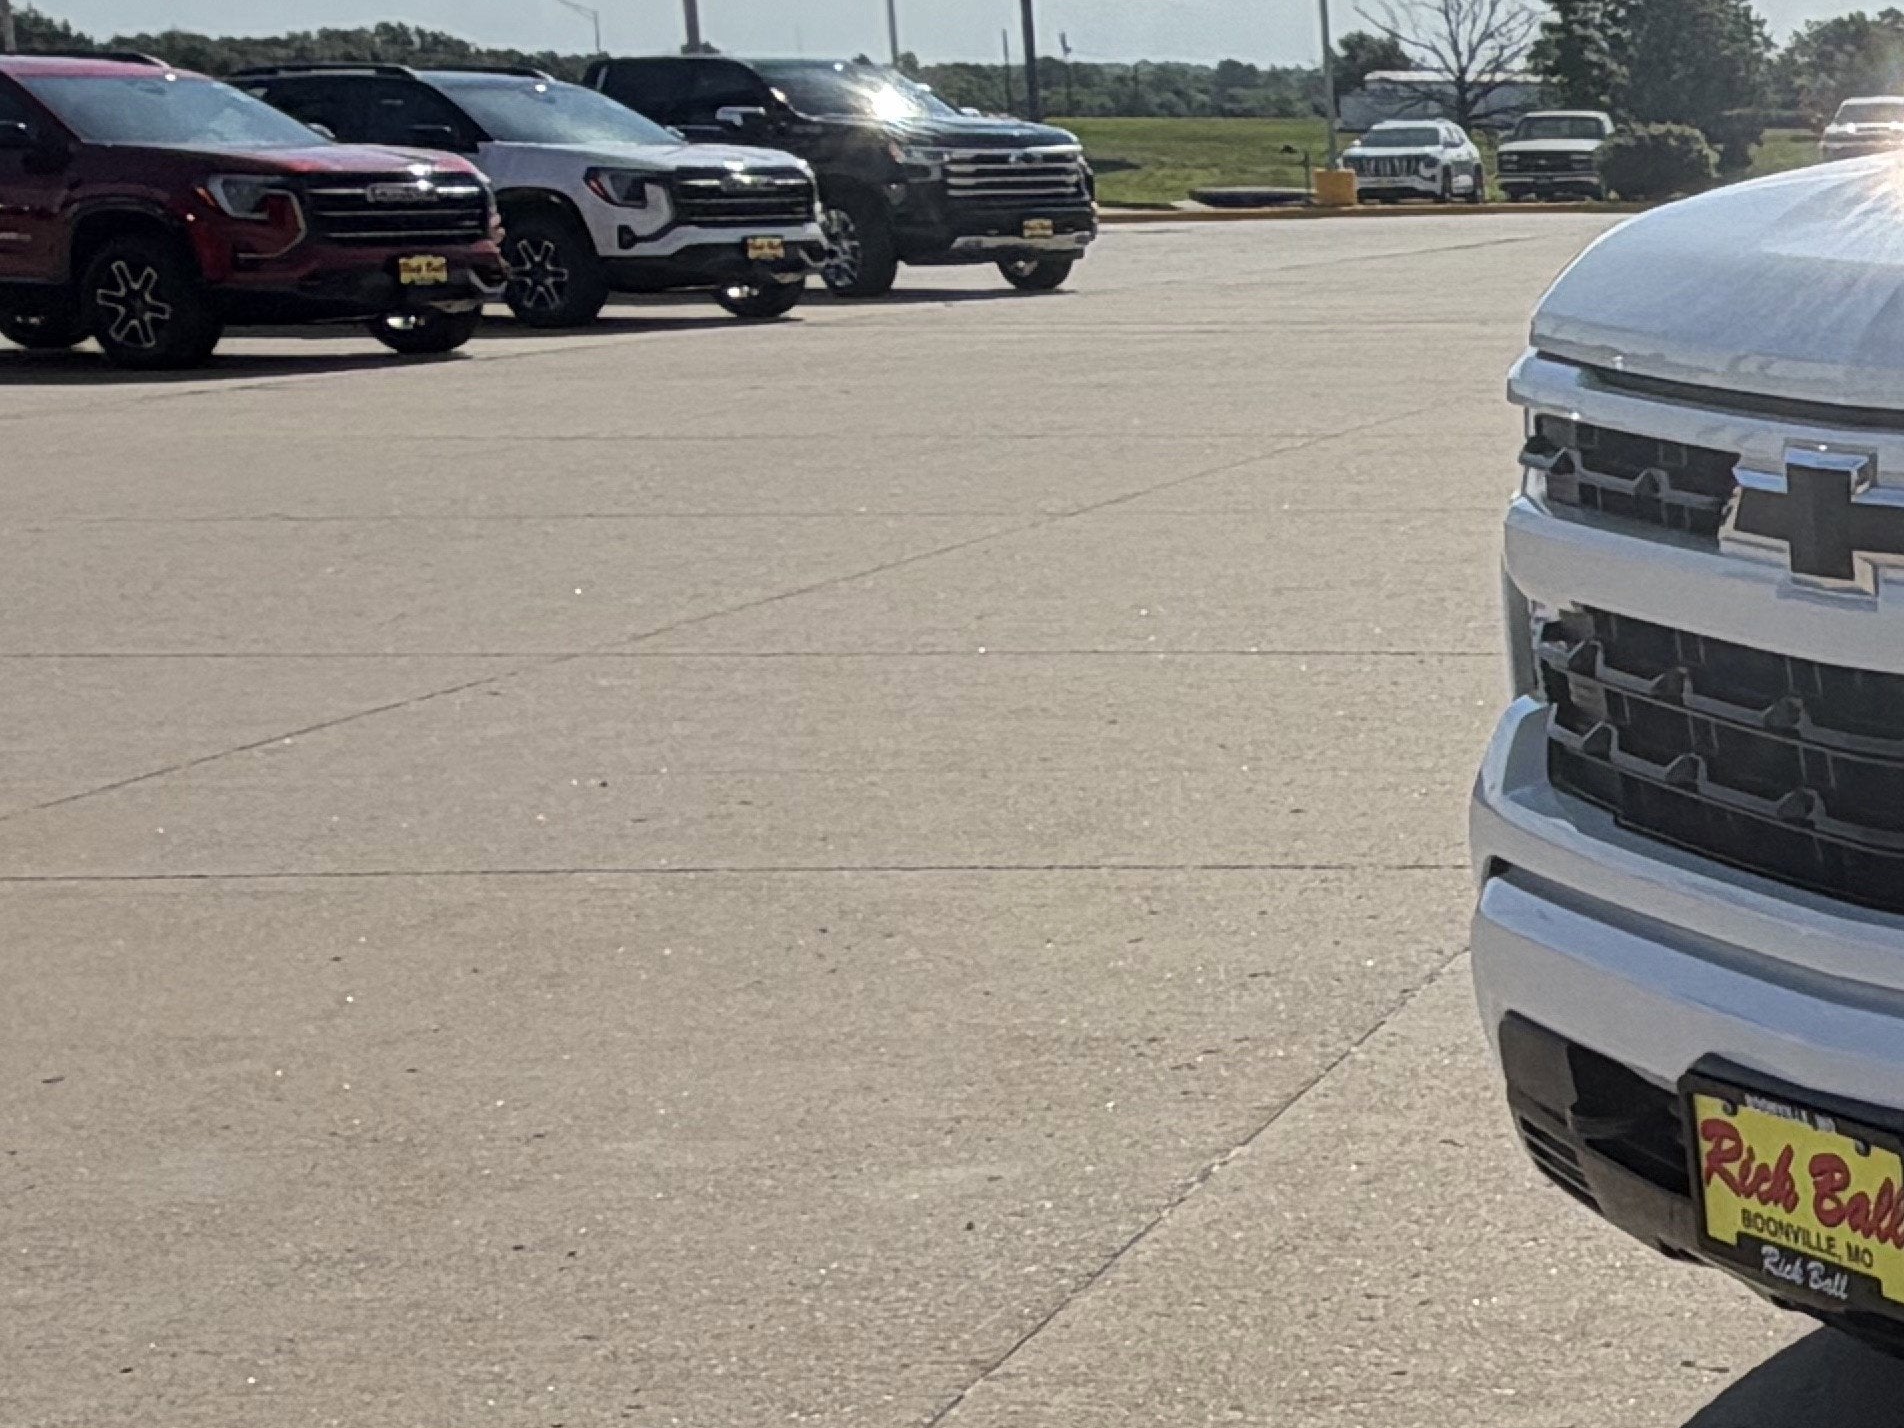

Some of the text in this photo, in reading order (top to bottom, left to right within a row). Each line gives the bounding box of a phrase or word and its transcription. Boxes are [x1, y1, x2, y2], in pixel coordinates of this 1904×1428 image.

[1701, 1118, 1799, 1214] Rick
[1741, 1208, 1873, 1268] BOONVILLE, MO
[1761, 1245, 1848, 1300] Rick Ball
